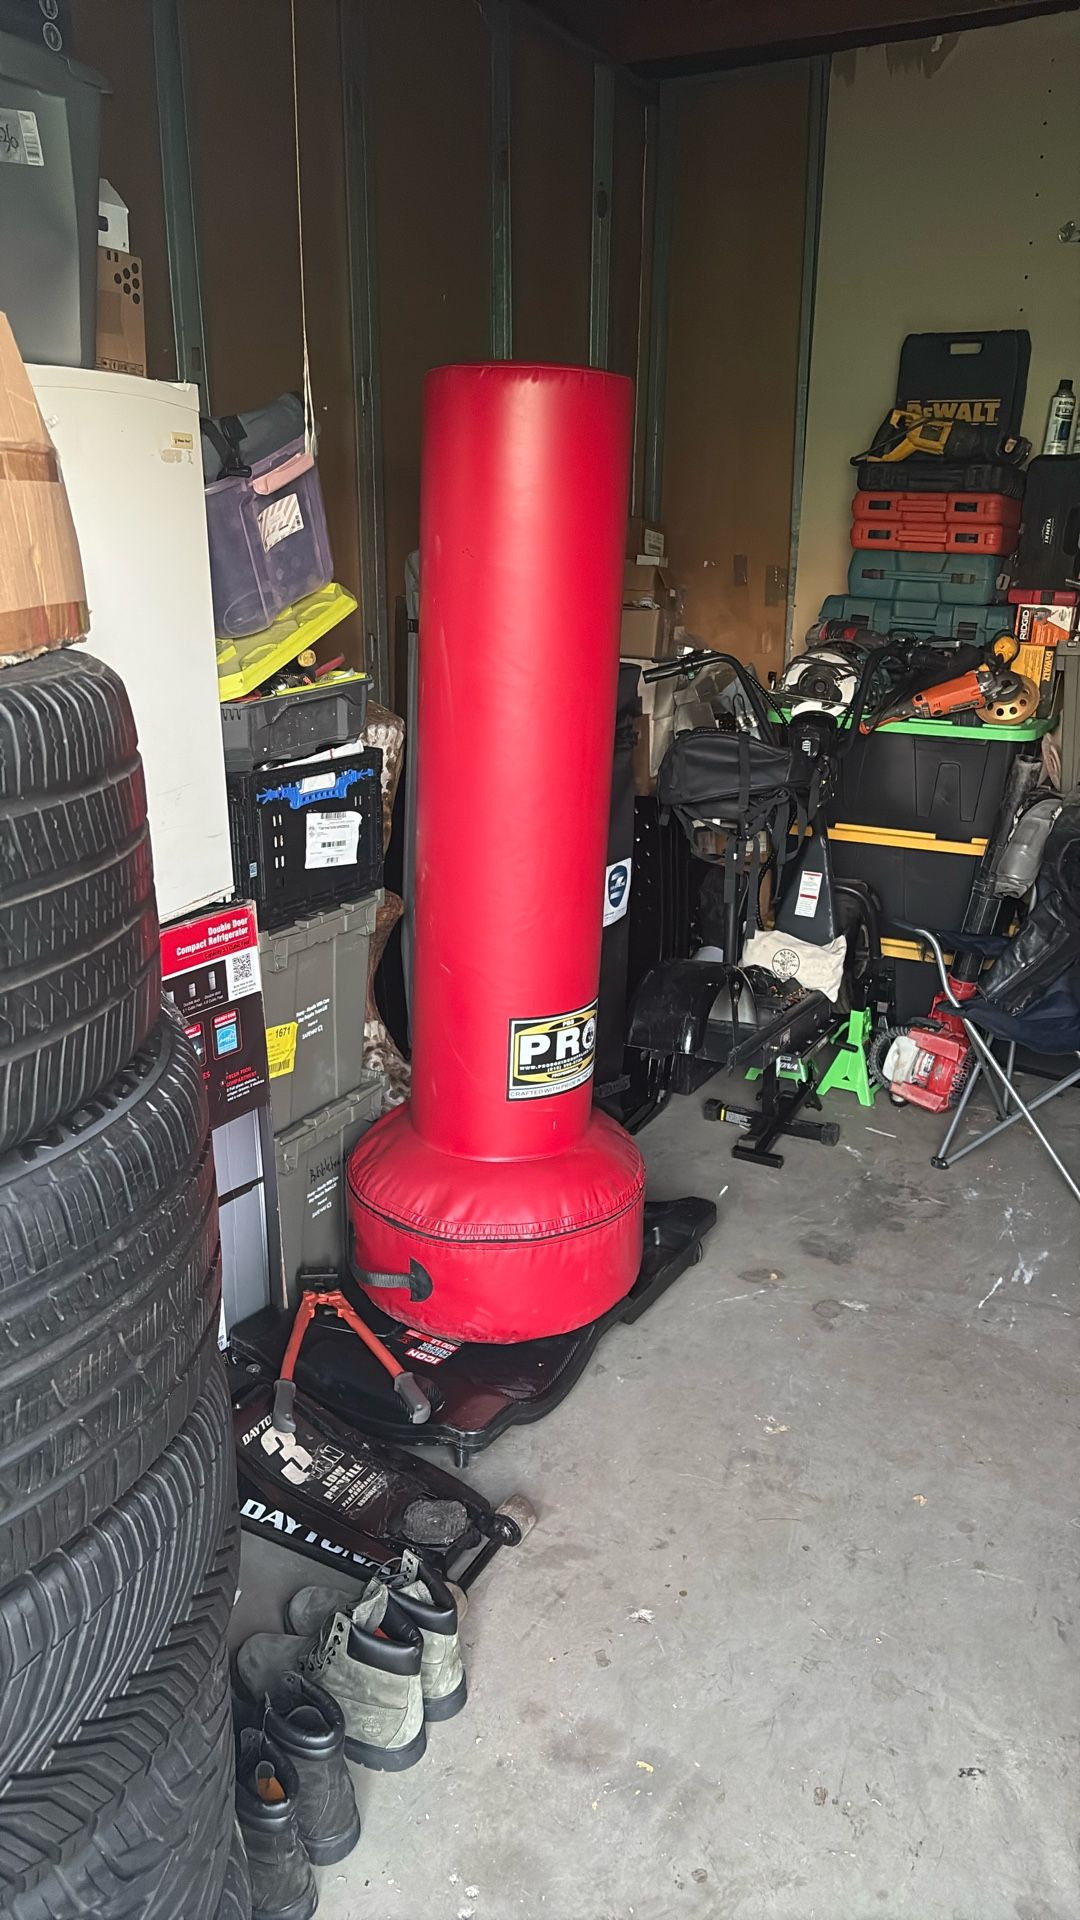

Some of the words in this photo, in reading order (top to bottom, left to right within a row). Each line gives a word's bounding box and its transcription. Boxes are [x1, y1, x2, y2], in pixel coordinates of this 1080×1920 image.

[1020, 609, 1030, 640] RIDGID
[208, 923, 231, 936] Double
[232, 917, 248, 927] Door
[176, 940, 207, 956] Compact
[208, 927, 248, 946] Refrigerator
[275, 1027, 291, 1039] 1671
[519, 1017, 595, 1066] PRO
[510, 1088, 544, 1098] CRAFTED
[544, 1085, 560, 1094] WITH
[560, 1079, 578, 1090] PRIDE
[407, 1349, 440, 1364] ICON
[260, 1426, 314, 1485] 3
[322, 1465, 346, 1488] LOW
[348, 1480, 362, 1494] HIGH
[342, 1472, 377, 1508] PERFORMANCE
